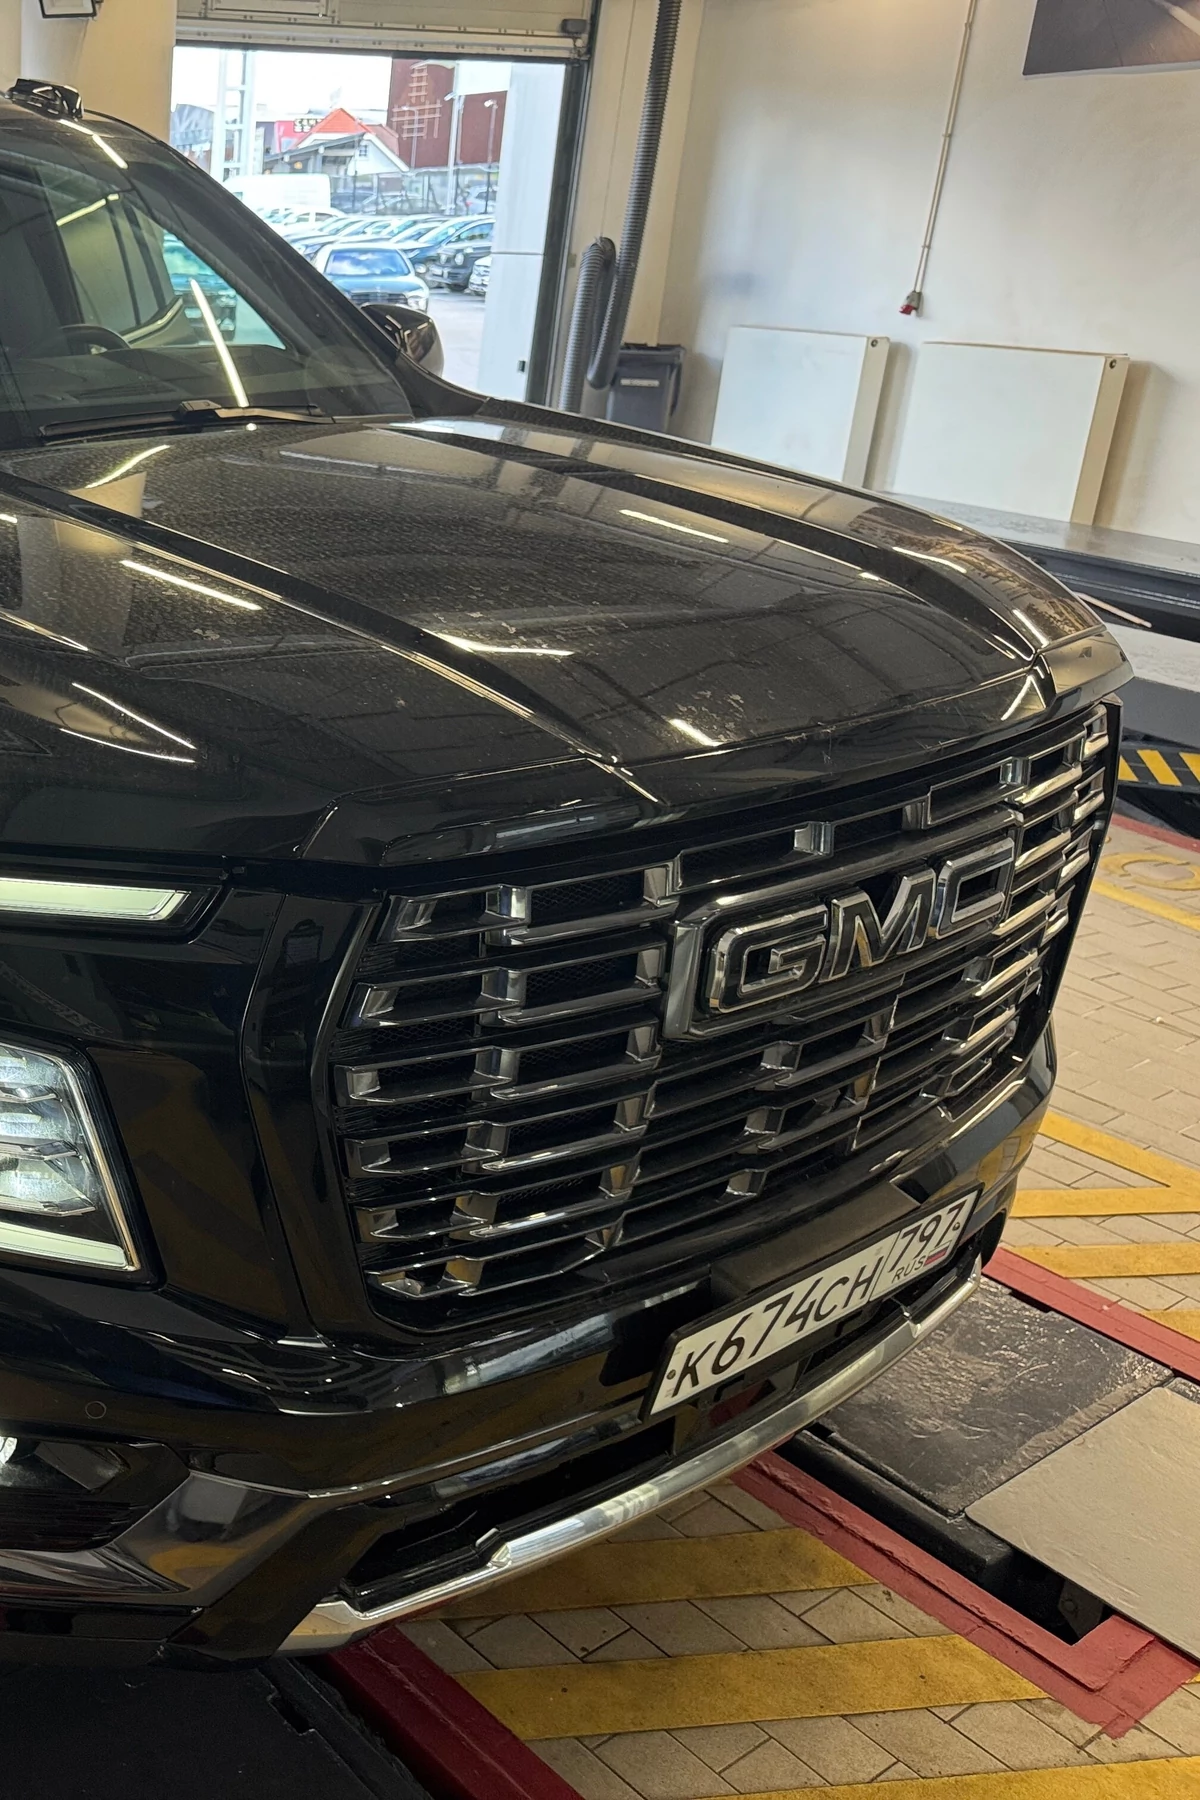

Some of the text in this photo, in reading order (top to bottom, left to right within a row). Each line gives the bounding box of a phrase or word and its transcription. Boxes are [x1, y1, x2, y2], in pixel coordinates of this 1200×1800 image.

[709, 836, 1015, 1014] GMC
[888, 1198, 968, 1274] 797
[891, 1255, 926, 1284] RUS
